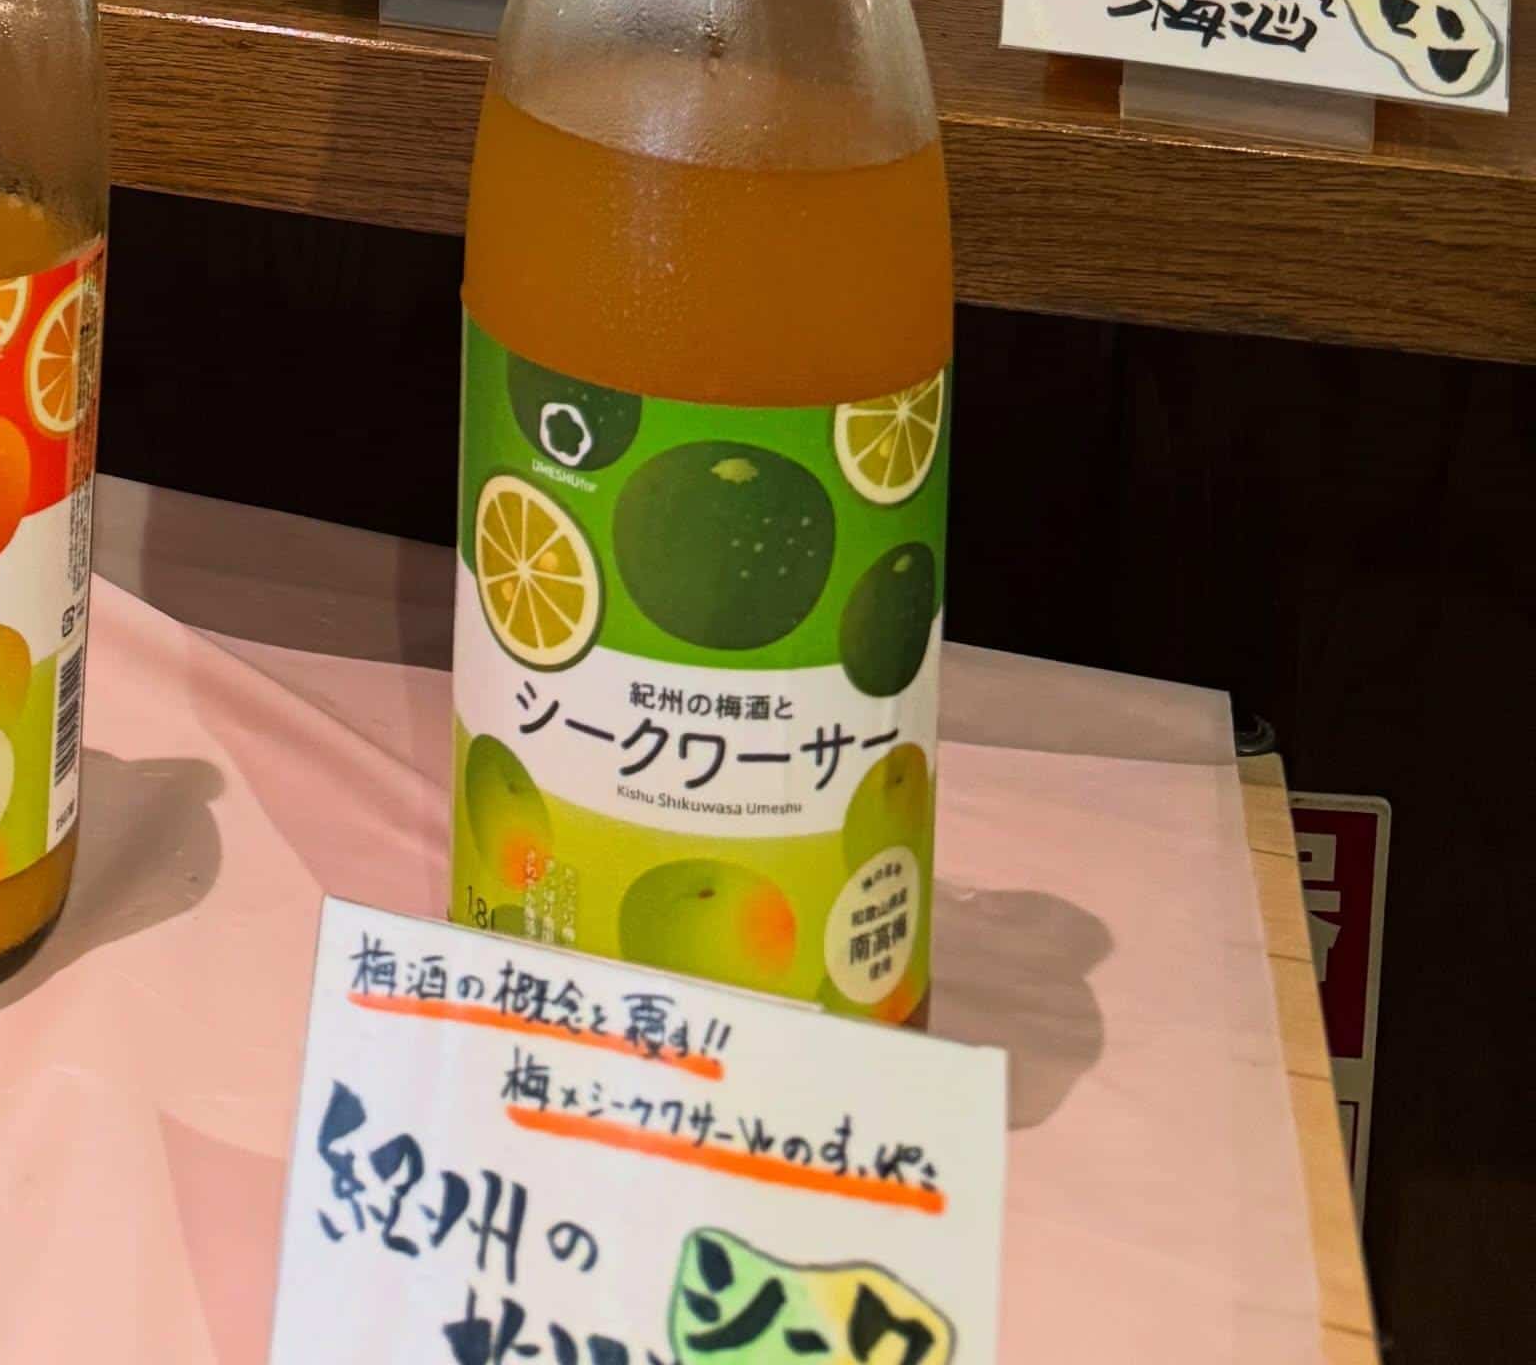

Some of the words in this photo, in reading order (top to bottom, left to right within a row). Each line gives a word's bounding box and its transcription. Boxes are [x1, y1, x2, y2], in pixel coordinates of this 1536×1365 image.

[514, 680, 900, 792] シークワーサー
[628, 680, 794, 721] 紀州の梅酒と
[616, 783, 656, 806] Kishu
[657, 791, 743, 817] Shikuwasa
[746, 799, 803, 816] Umeshu
[317, 1079, 601, 1283] 紀州の
